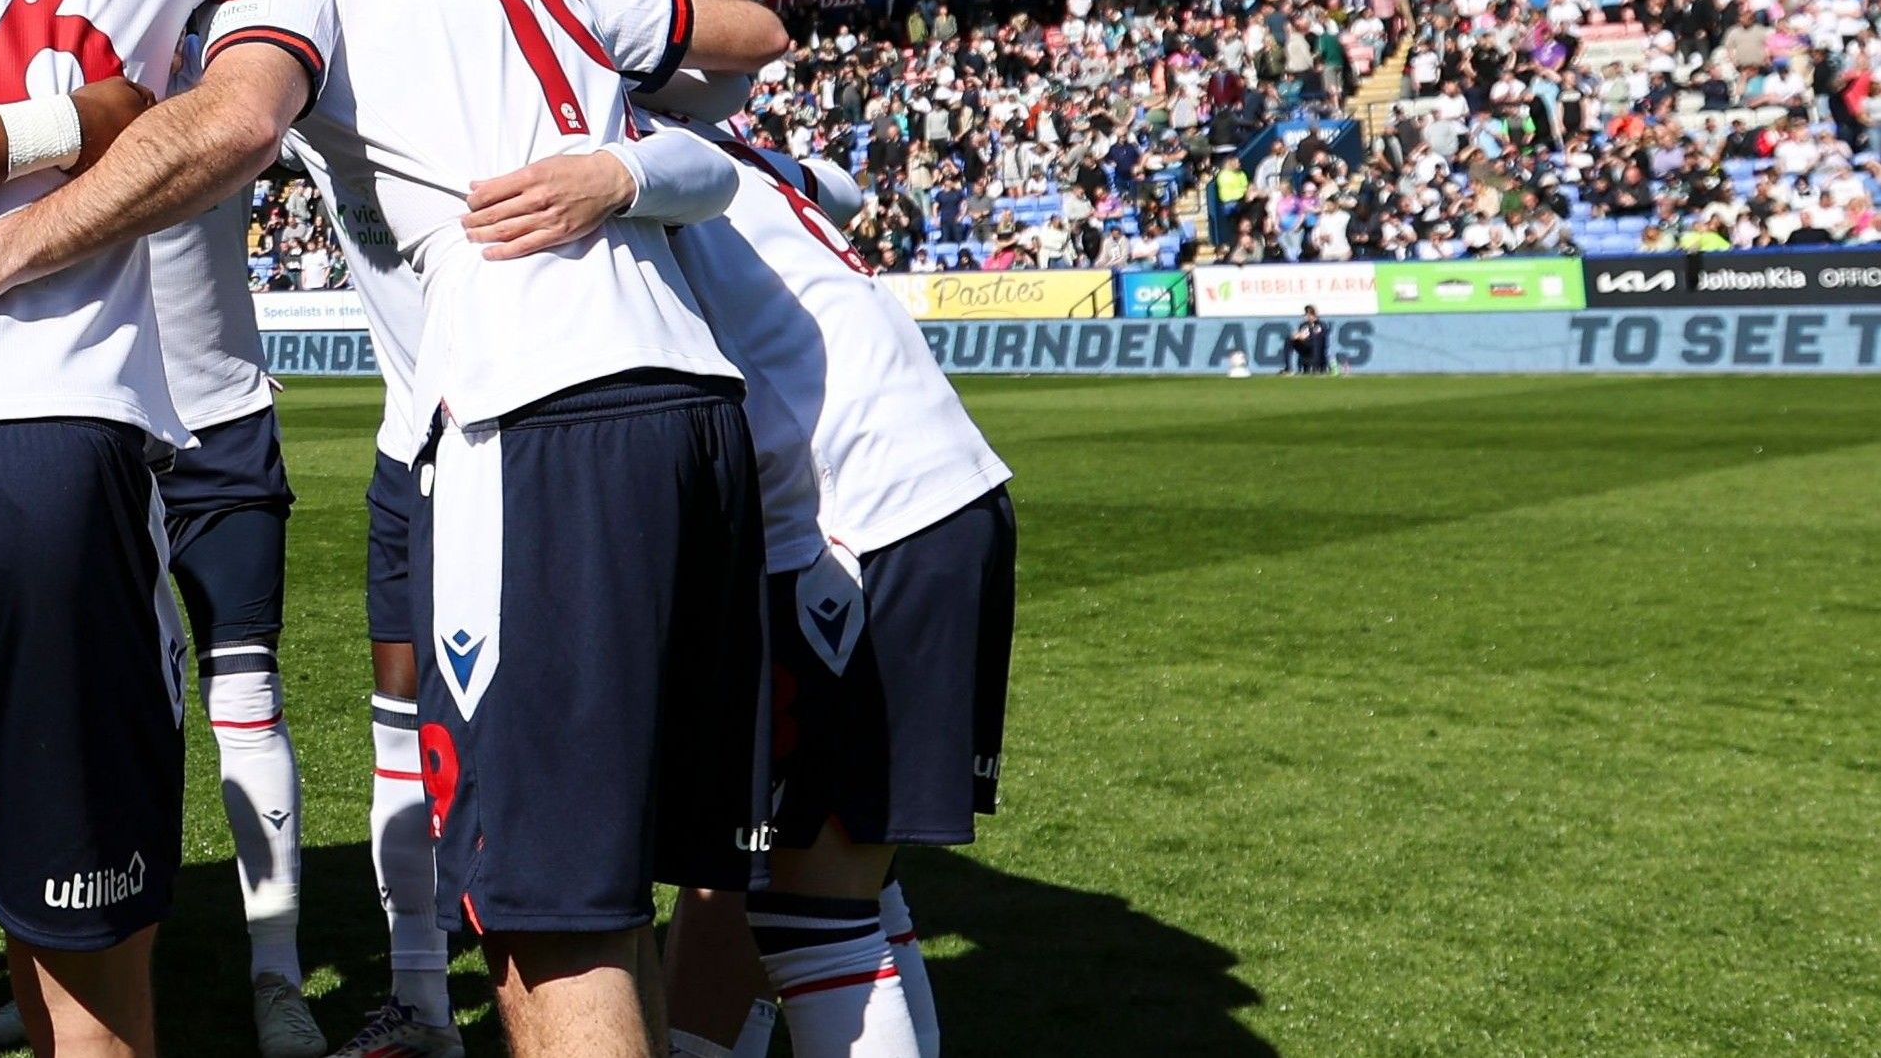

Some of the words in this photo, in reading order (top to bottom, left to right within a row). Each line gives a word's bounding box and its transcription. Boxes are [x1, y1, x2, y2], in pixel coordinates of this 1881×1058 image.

[932, 276, 1045, 309] Pasties
[1241, 278, 1308, 295] RIBBLE
[263, 306, 322, 319] Specialists
[326, 306, 335, 316] in
[922, 322, 1206, 372] BURNDEN
[1208, 316, 1376, 370] ACS
[1570, 315, 1665, 365] TO
[1681, 314, 1826, 364] SEE
[44, 868, 129, 910] utilita
